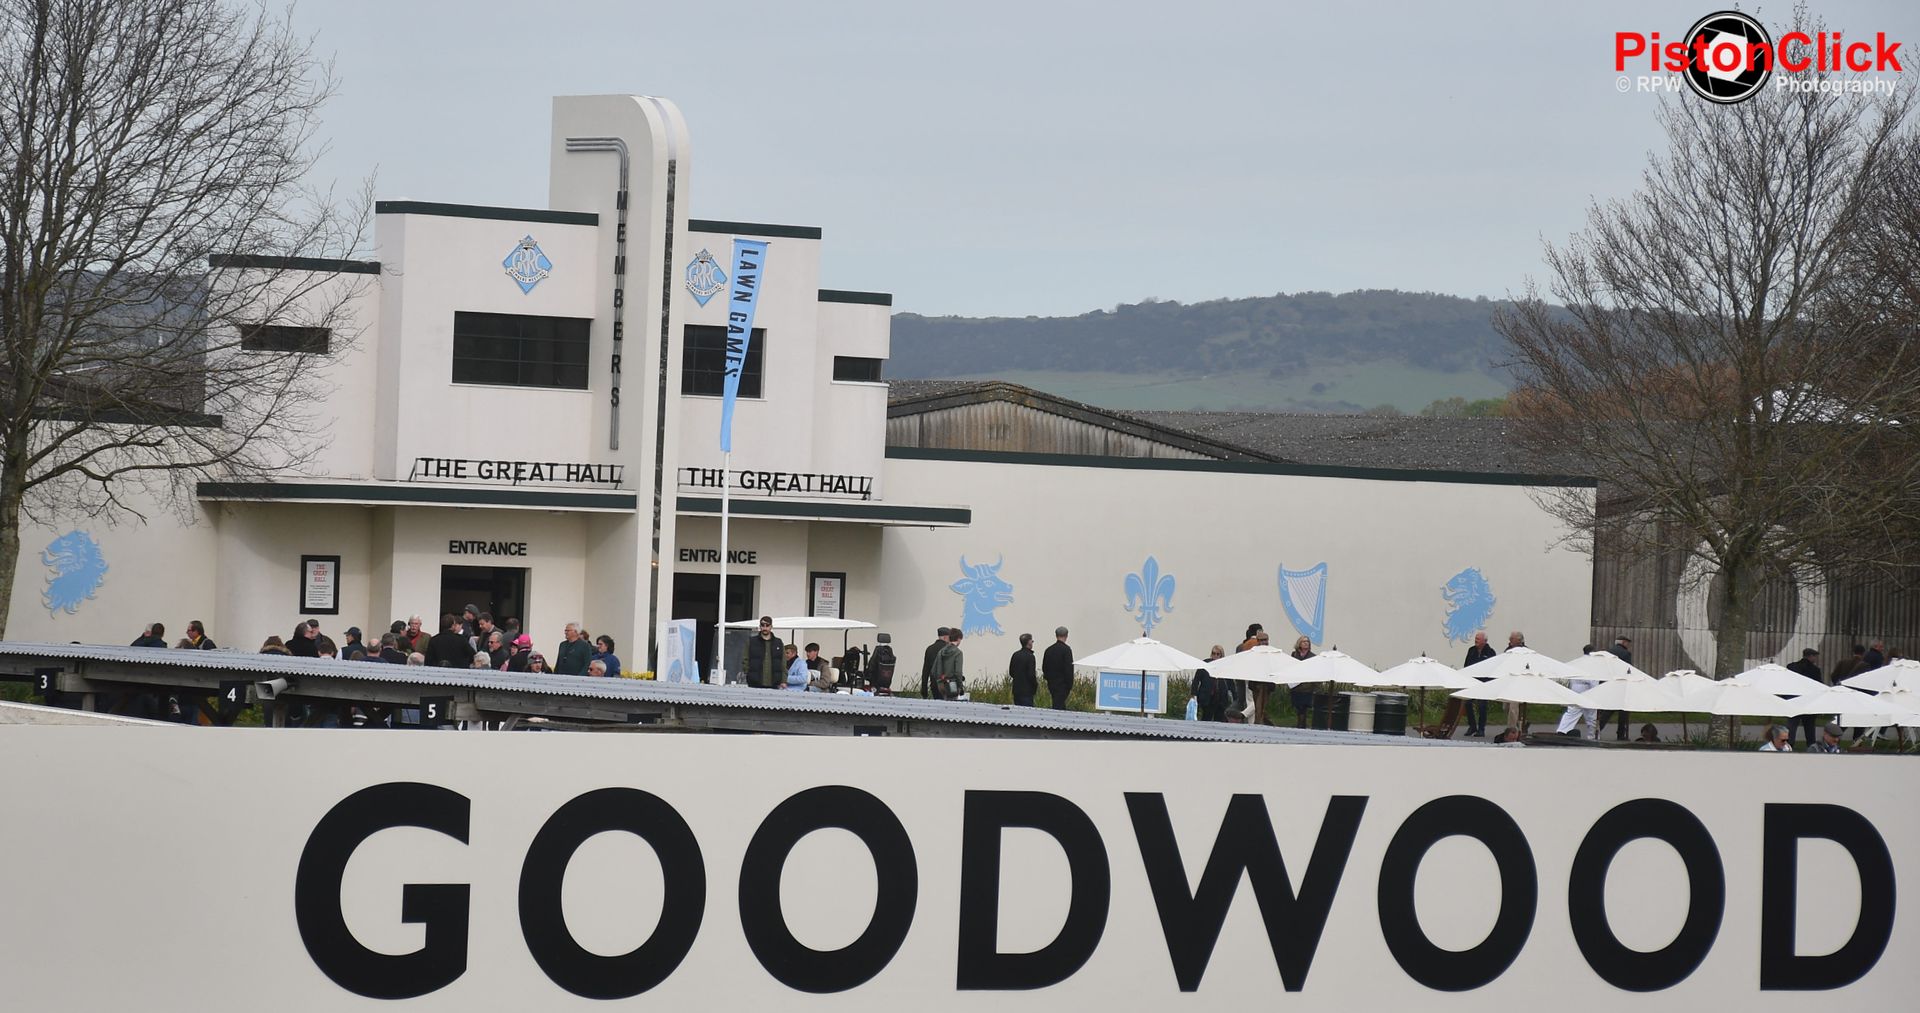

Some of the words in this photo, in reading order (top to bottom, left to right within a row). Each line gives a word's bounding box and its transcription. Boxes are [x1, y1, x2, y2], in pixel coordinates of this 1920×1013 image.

[733, 248, 759, 303] LAWN
[611, 190, 628, 409] MEMBERS
[420, 457, 468, 479] THE
[477, 460, 559, 482] GREAT
[566, 464, 623, 484] HALL
[740, 470, 816, 492] GREAT
[820, 474, 872, 495] HALL
[448, 540, 528, 556] ENTRANCE
[39, 675, 48, 690] 3
[226, 687, 237, 702] 4
[427, 703, 437, 720] 5
[294, 781, 1897, 1000] GOODWOOD
